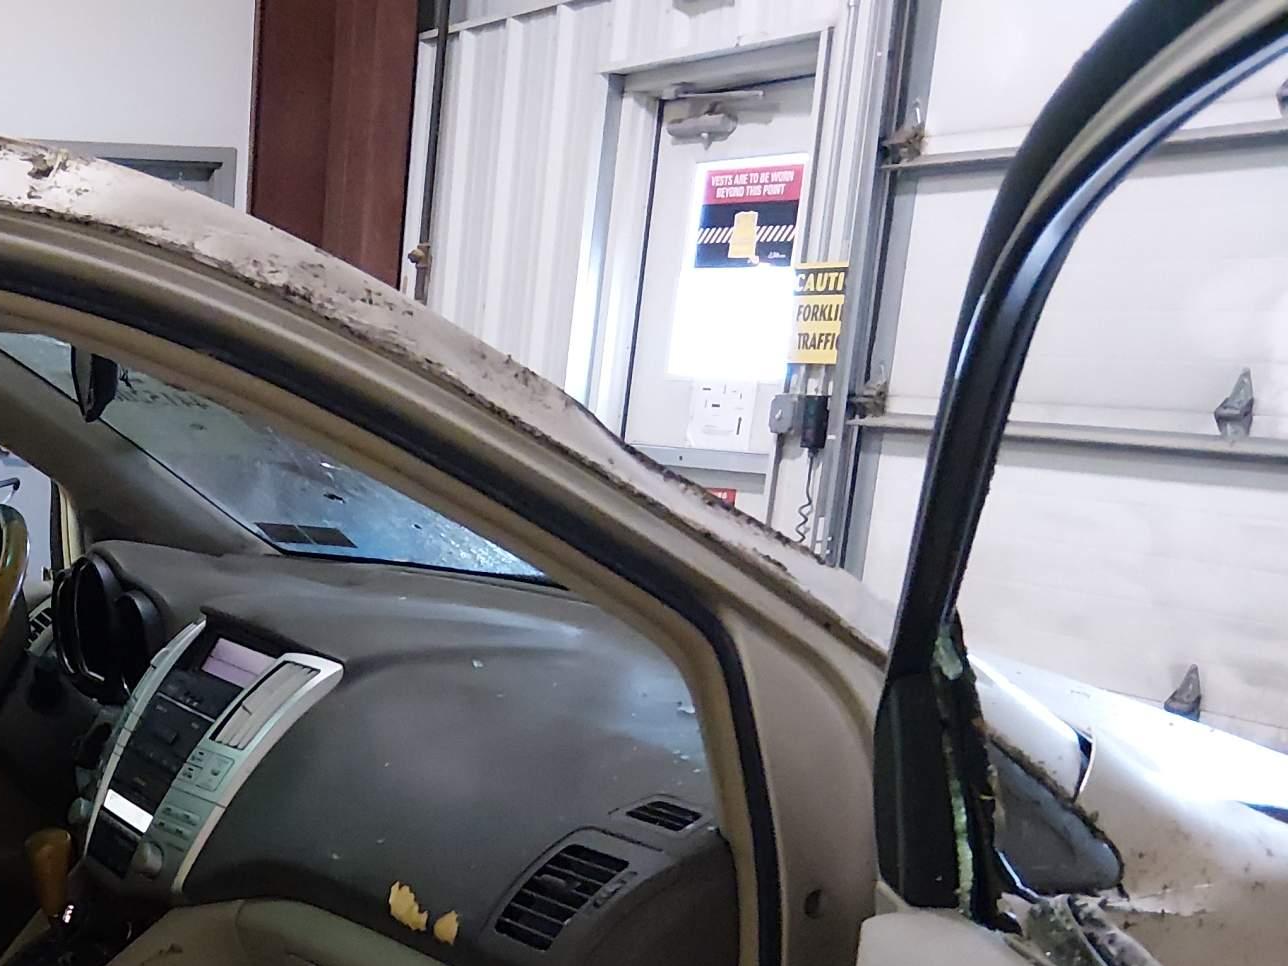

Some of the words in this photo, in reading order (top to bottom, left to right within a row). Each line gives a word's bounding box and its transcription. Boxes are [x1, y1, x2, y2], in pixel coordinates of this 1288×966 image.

[711, 174, 733, 187] VESTS
[733, 173, 748, 185] ARE
[749, 172, 759, 184] TO
[759, 171, 770, 183] BE
[771, 170, 795, 183] WORN
[715, 186, 745, 199] BEYOND
[745, 185, 762, 197] THIS
[762, 183, 786, 196] POINT
